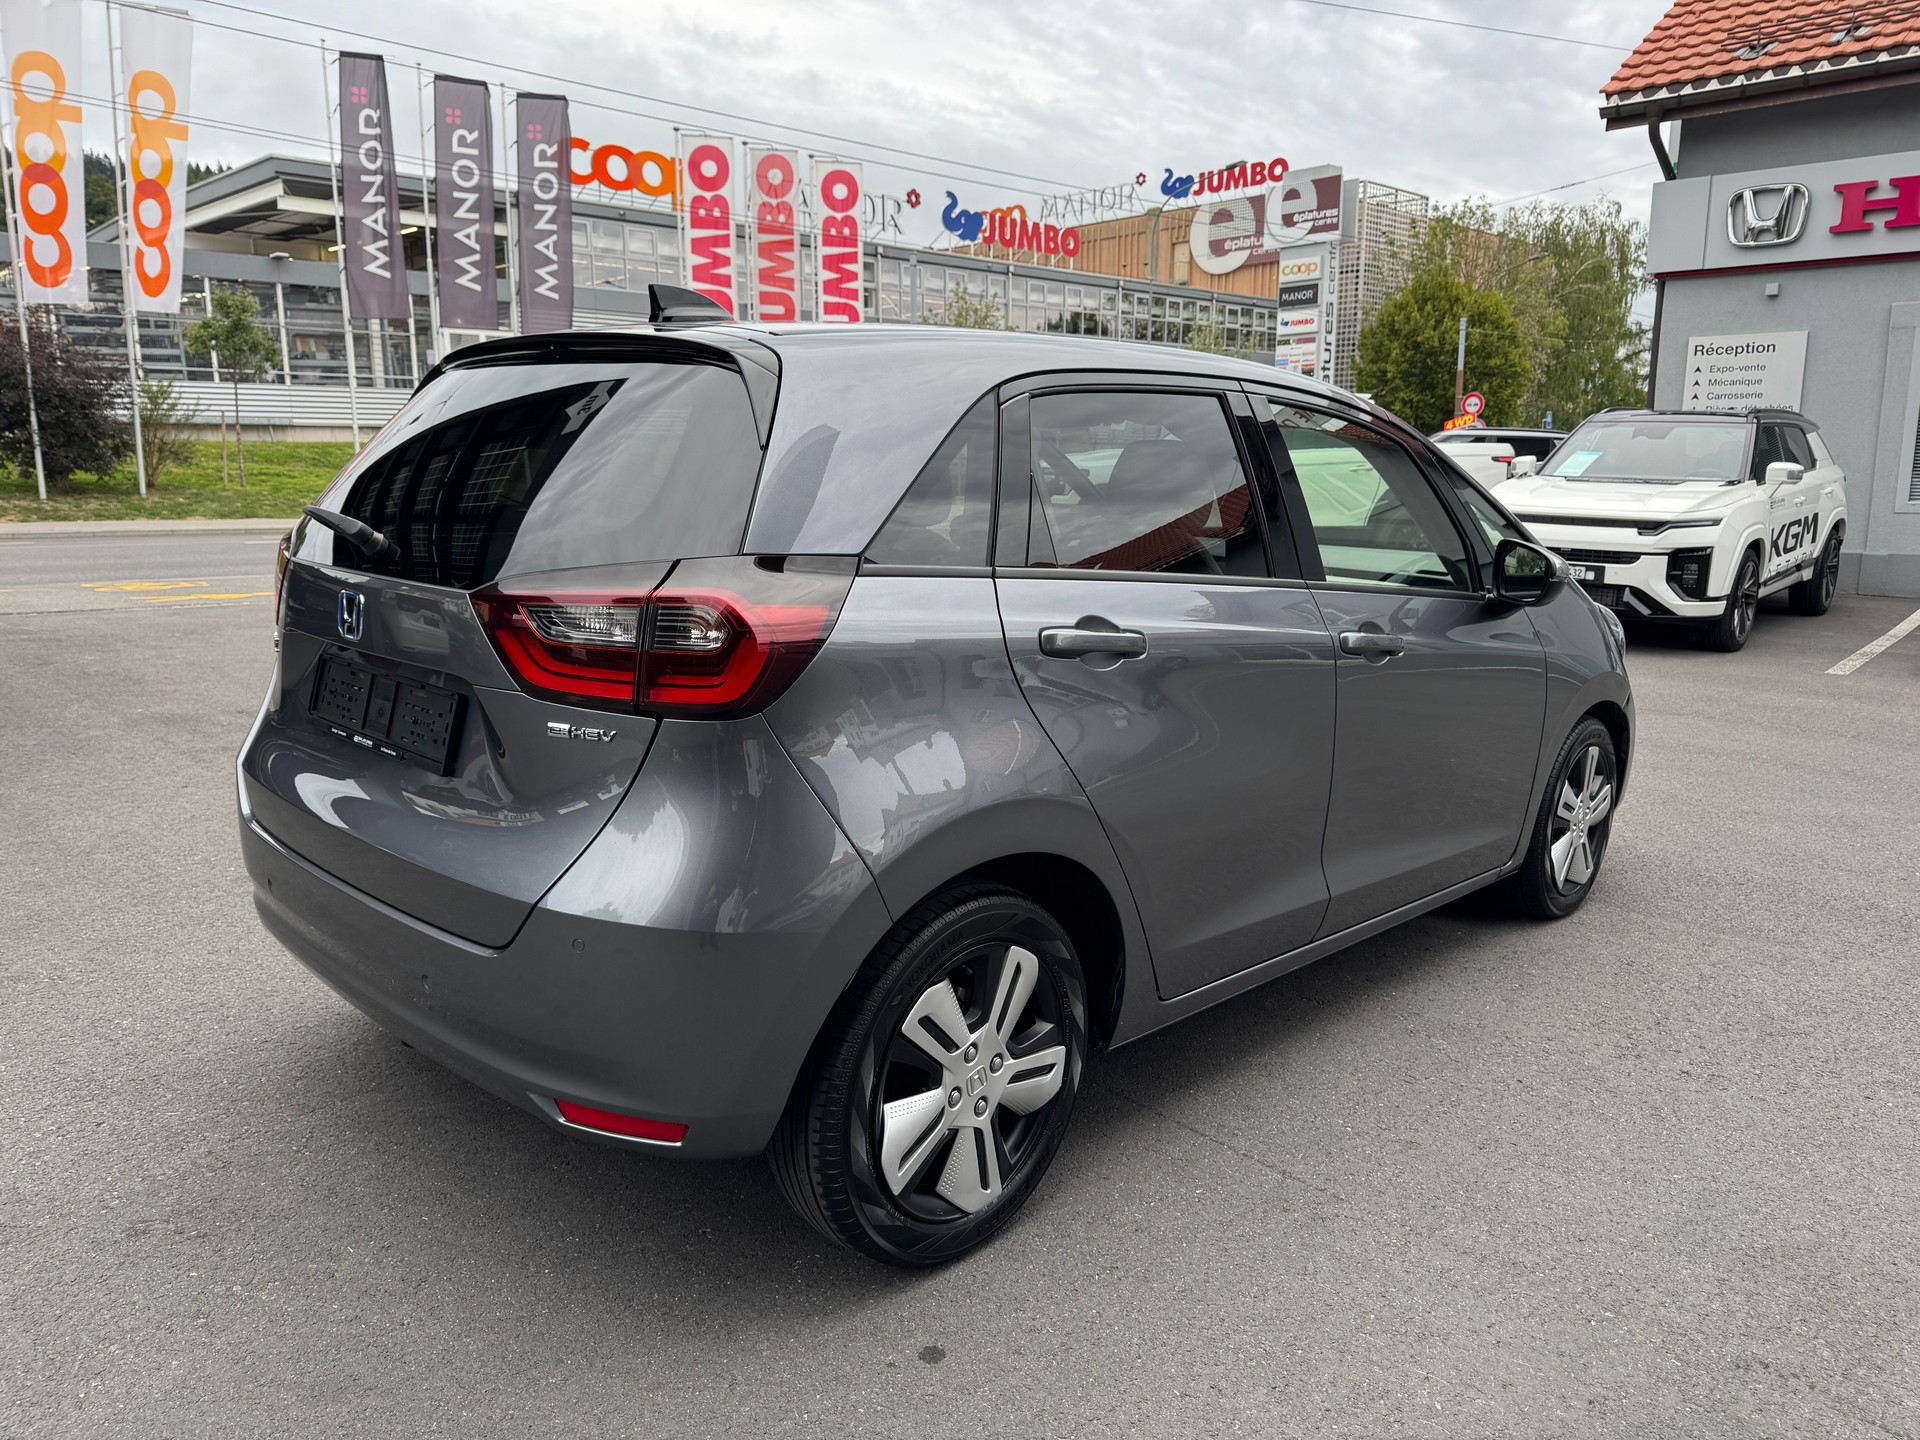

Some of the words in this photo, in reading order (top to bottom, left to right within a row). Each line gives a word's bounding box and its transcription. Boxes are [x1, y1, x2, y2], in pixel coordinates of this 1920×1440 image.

[11, 50, 83, 289] coop
[1193, 157, 1289, 197] JUMBO
[128, 69, 190, 299] coop
[358, 107, 392, 280] MANOR
[452, 127, 482, 293] MANOR
[1293, 208, 1339, 224] éplatures
[533, 142, 560, 301] MANOR
[1314, 217, 1338, 227] centre
[982, 211, 1081, 258] JUMBO
[1224, 236, 1264, 251] éplatu
[1281, 262, 1318, 276] coop
[1281, 289, 1314, 302] MANOR
[1320, 301, 1334, 384] atures
[1328, 240, 1337, 295] centr
[1289, 318, 1315, 327] JUMBO
[1693, 341, 1777, 357] Réception
[1709, 363, 1767, 374] Expo-vente
[1707, 377, 1763, 387] Mécanique
[1706, 391, 1764, 401] Carrosserie
[1768, 511, 1819, 563] KGM
